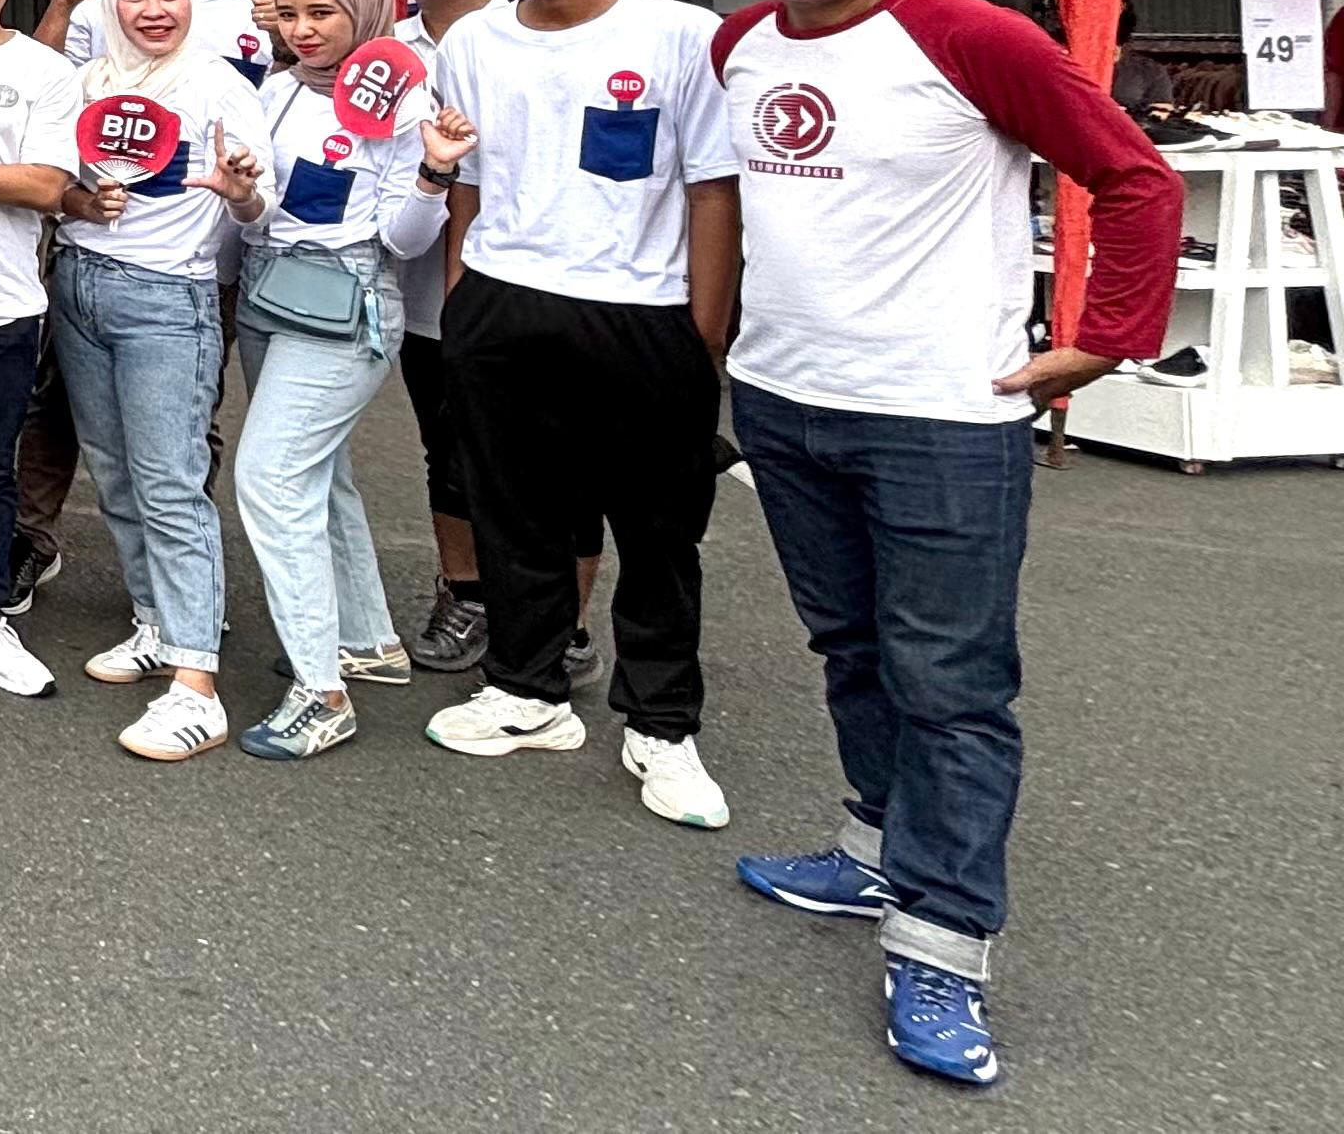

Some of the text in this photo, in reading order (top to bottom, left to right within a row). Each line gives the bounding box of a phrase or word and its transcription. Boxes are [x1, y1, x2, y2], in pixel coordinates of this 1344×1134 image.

[1256, 35, 1294, 63] 49
[349, 59, 392, 112] BID
[610, 79, 642, 92] BID
[101, 114, 157, 141] BID
[325, 138, 350, 155] BID
